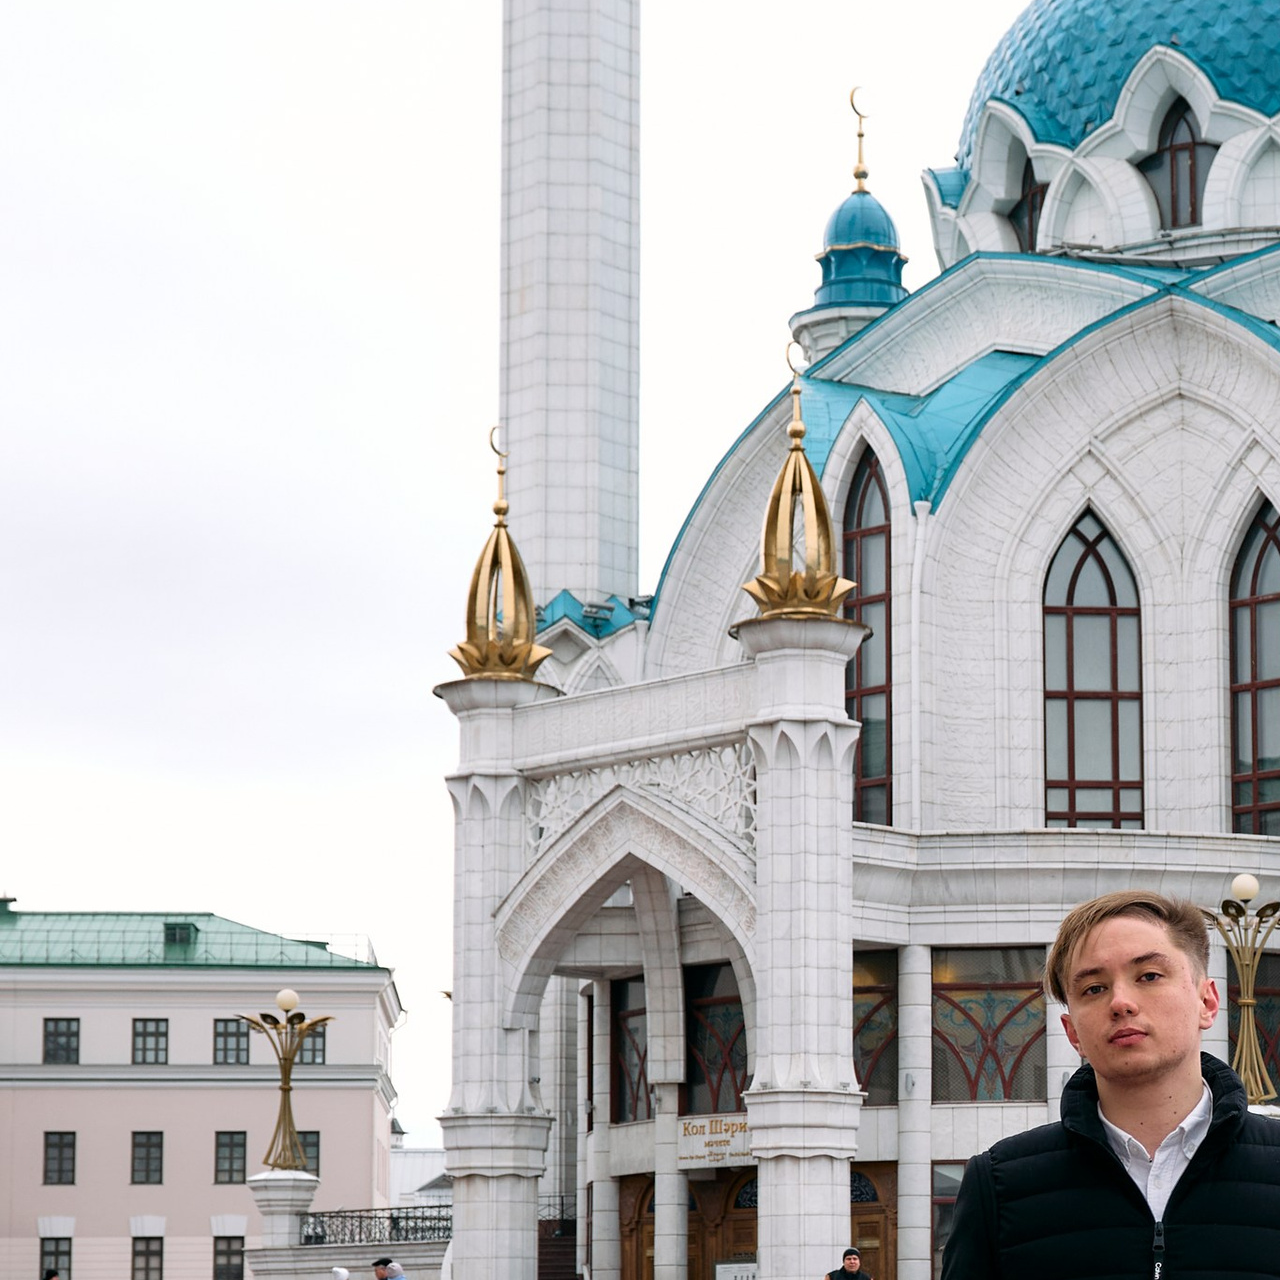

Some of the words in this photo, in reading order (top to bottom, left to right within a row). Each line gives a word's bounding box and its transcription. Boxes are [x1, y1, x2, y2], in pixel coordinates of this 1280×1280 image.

[683, 1122, 706, 1136] Кол
[709, 1119, 748, 1138] Шәри
[1154, 1262, 1162, 1280] Calvin
